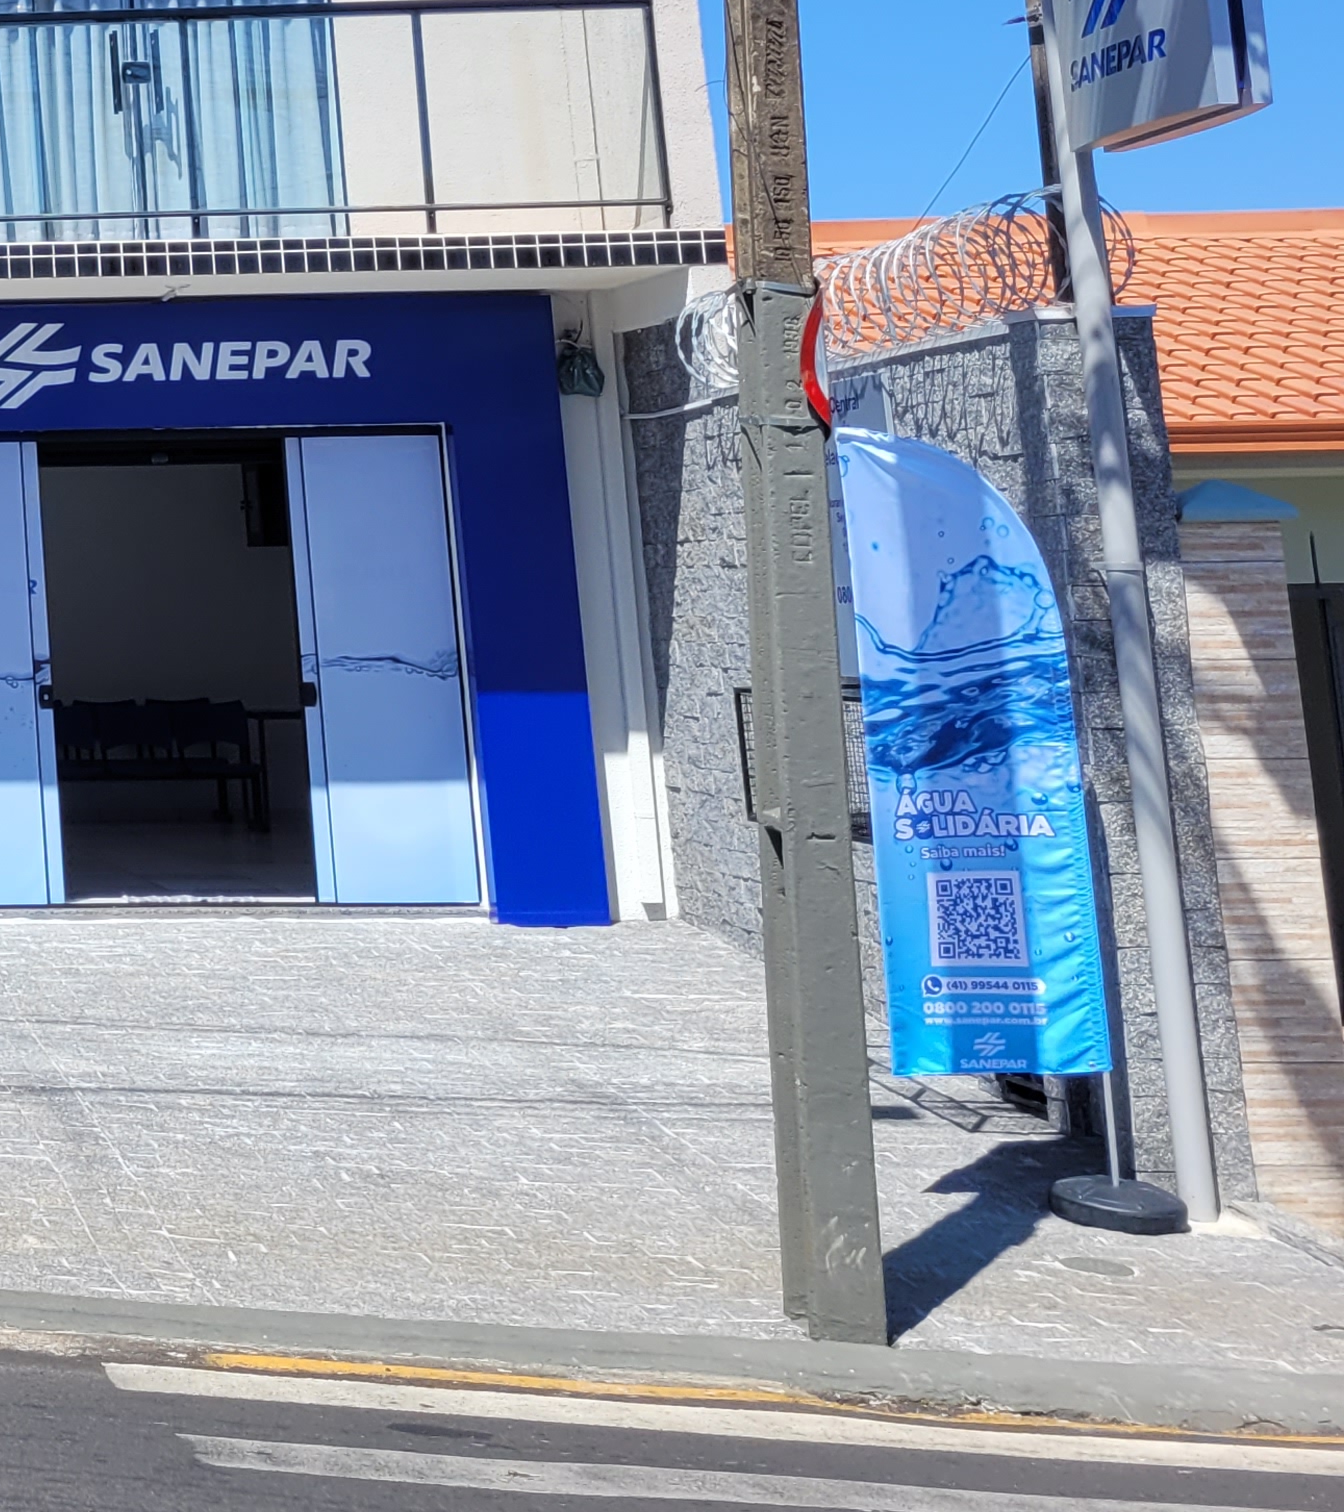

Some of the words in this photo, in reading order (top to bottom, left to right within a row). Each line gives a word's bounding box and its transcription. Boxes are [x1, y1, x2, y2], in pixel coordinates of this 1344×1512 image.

[1070, 28, 1167, 93] SANEPAR
[88, 339, 372, 383] SANEPAR
[896, 787, 977, 816] ÁGUA
[920, 845, 959, 859] Saiba
[963, 844, 1006, 857] mais!
[946, 980, 968, 991] (41)
[970, 980, 1009, 990] 99544
[1012, 981, 1039, 991] 0115
[923, 1001, 968, 1015] 0800
[970, 1001, 1005, 1014] 200
[1008, 1002, 1047, 1015] 0115
[923, 1017, 1048, 1025] www.sanepar.com.br
[960, 1058, 1027, 1069] SANEPAR
